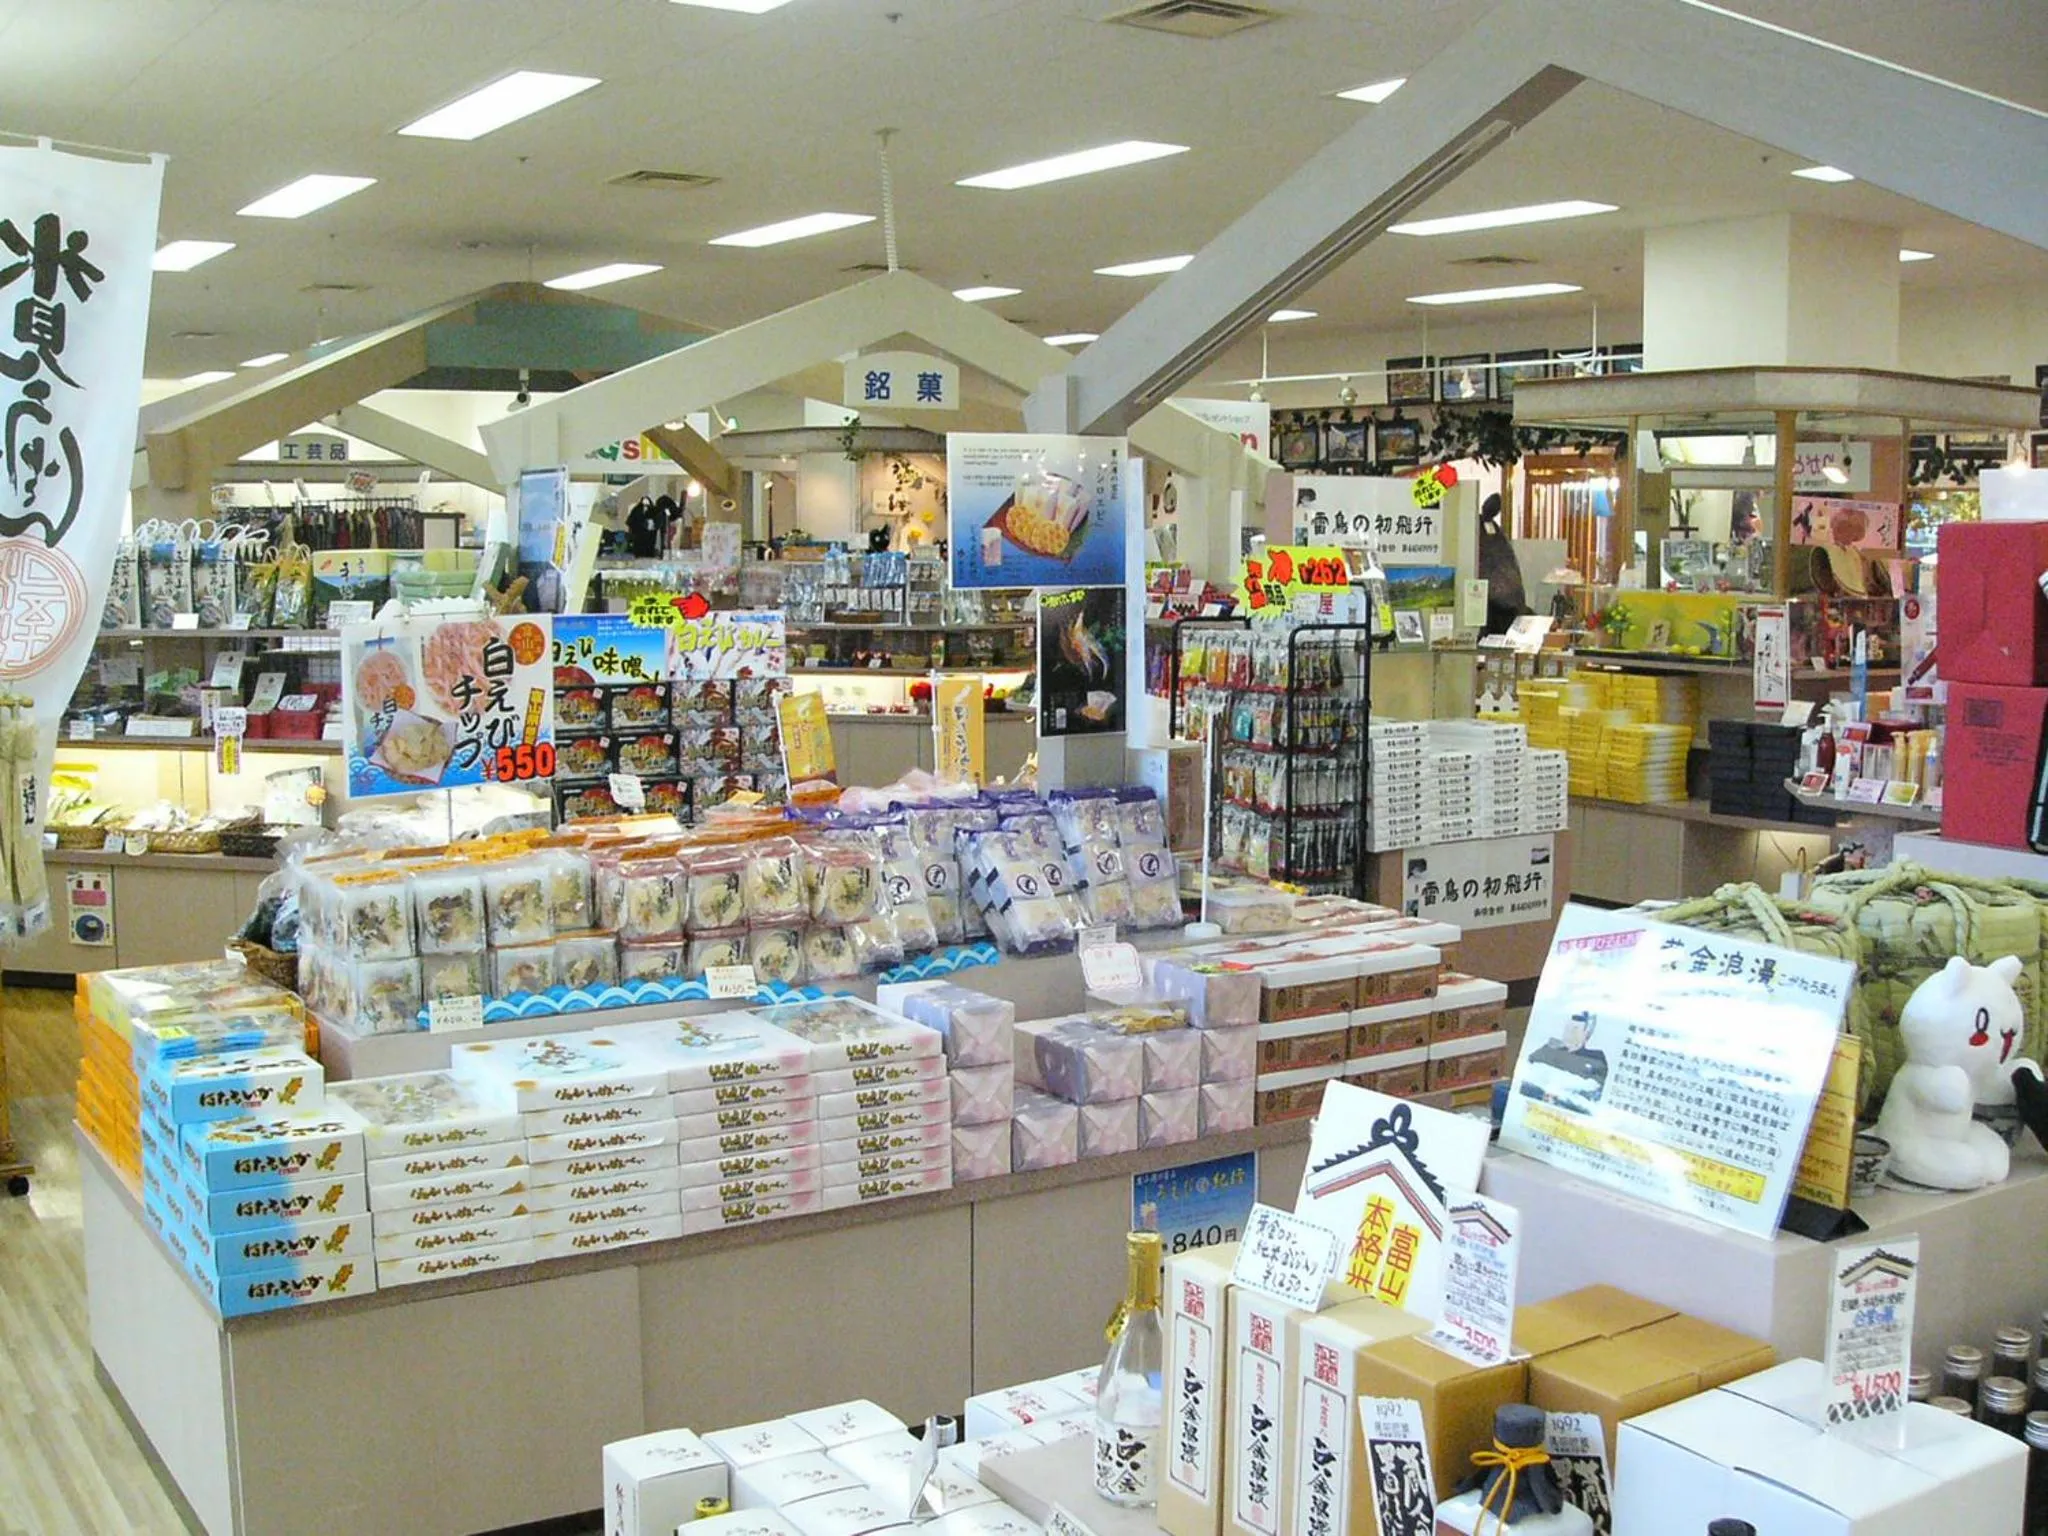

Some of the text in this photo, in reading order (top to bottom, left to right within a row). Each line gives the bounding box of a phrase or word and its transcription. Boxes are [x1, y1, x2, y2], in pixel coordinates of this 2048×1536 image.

[864, 370, 943, 402] 銘菓
[283, 443, 345, 460] 工芸品
[1310, 511, 1433, 536] 雷鳥の初飛行
[450, 674, 485, 769] チップ
[482, 636, 521, 750] 白えび
[1421, 870, 1543, 907] 雷鳥の初飛行
[1346, 1195, 1391, 1294] 本格米
[1377, 1223, 1420, 1304] 富山
